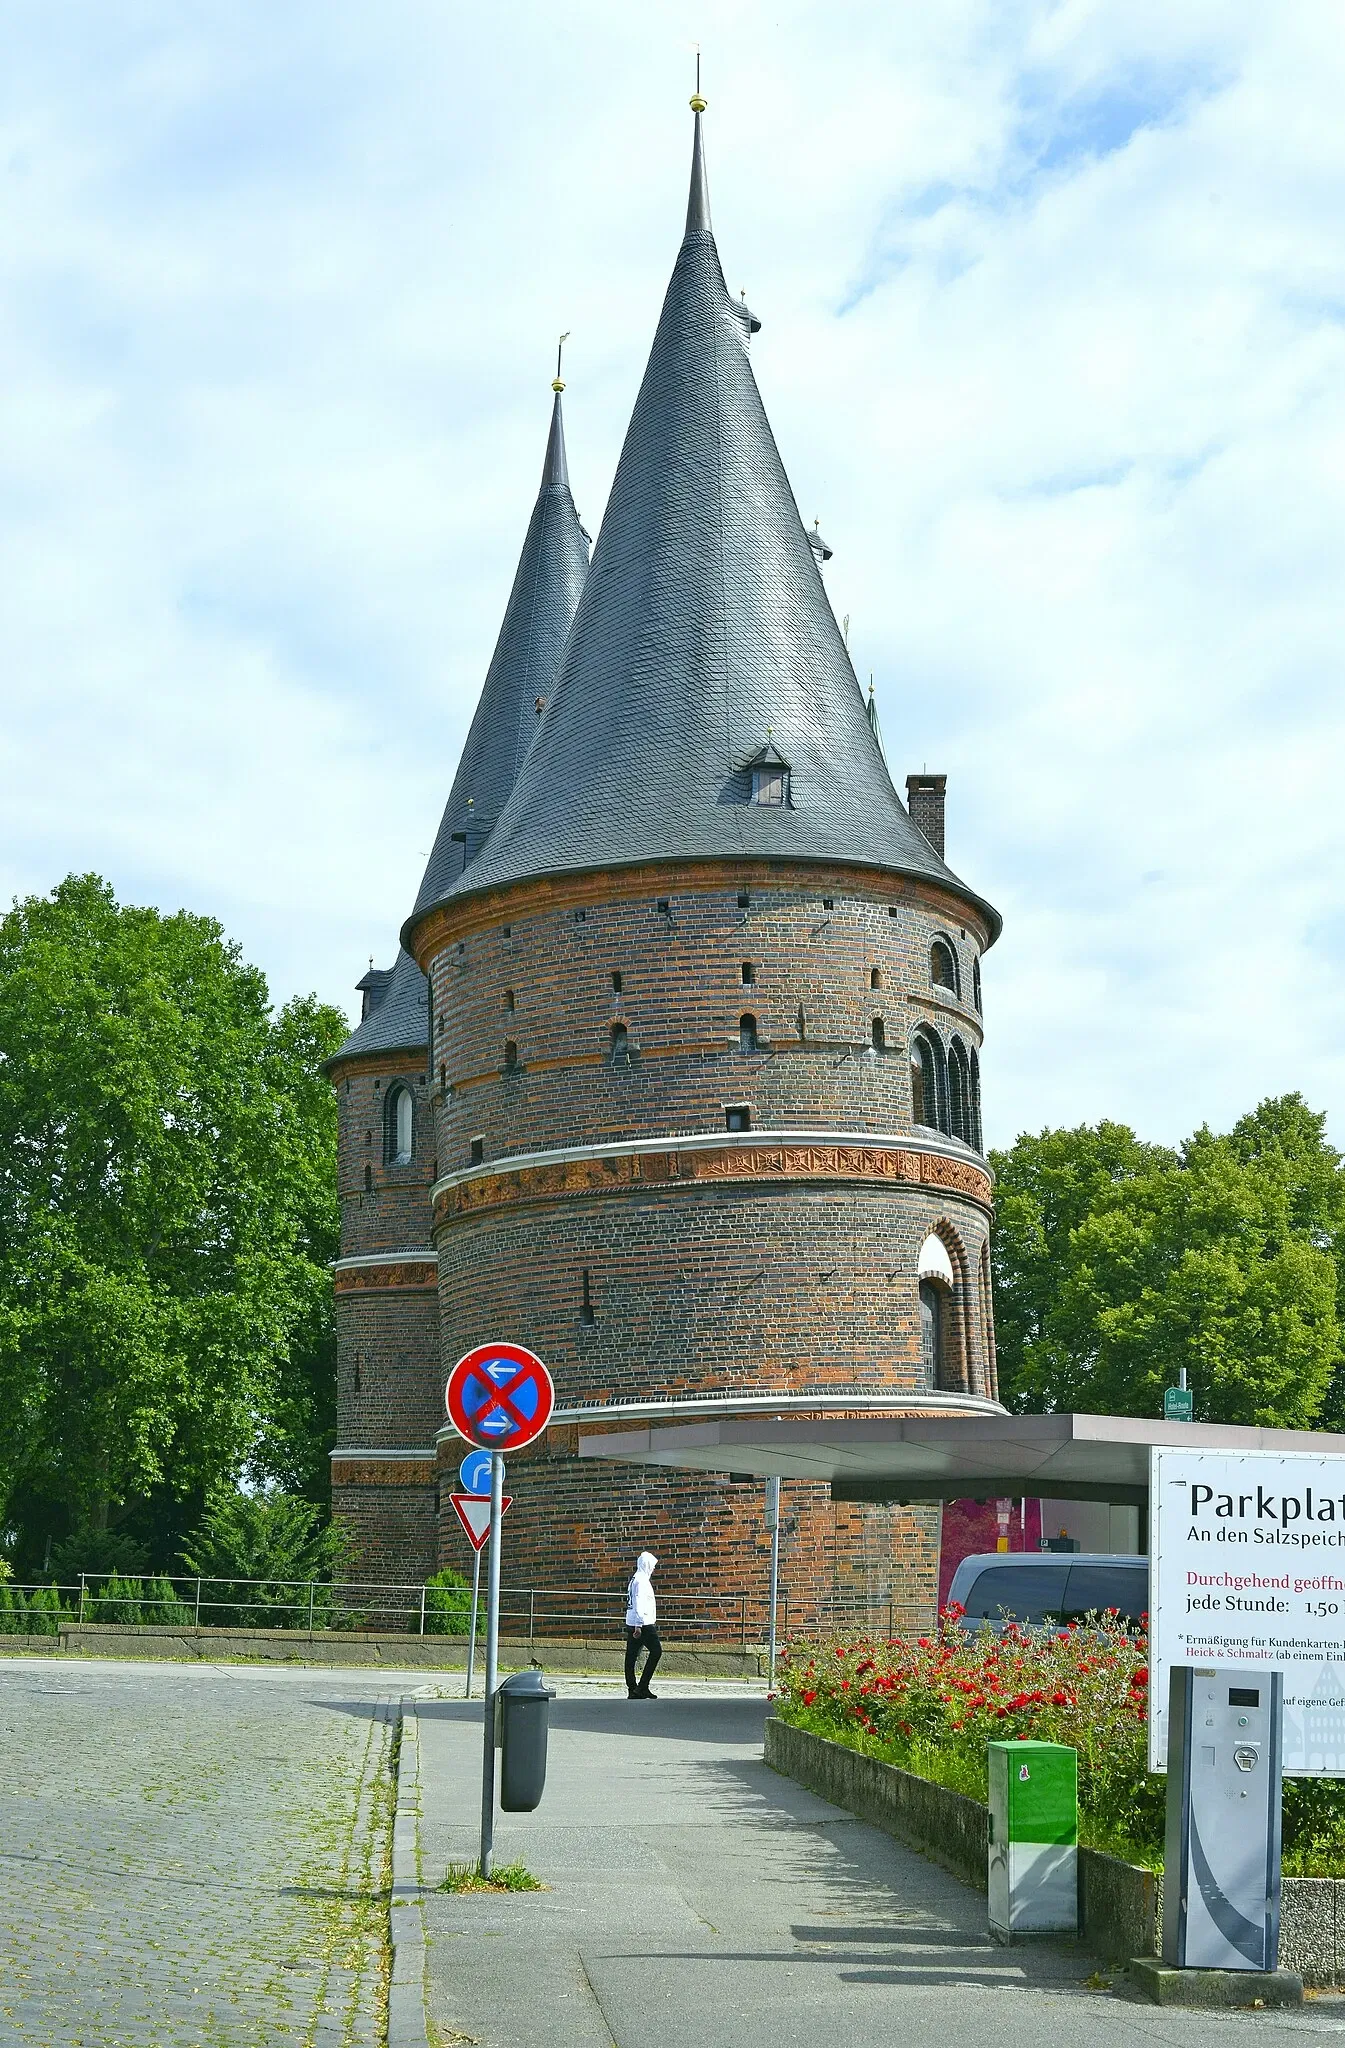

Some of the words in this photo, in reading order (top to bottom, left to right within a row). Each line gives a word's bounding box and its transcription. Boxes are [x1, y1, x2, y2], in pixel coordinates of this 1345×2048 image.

[1187, 1526, 1211, 1541] An
[1216, 1526, 1248, 1543] den
[1253, 1528, 1345, 1549] Salzspeich
[1187, 1571, 1290, 1591] Durchgehend
[1294, 1575, 1345, 1593] geöffn
[1186, 1594, 1221, 1613] jede
[1225, 1596, 1289, 1612] Stunde:
[1304, 1601, 1339, 1618] 1,50
[1186, 1635, 1249, 1648] Ermäßigung
[1251, 1636, 1267, 1647] für
[1186, 1647, 1215, 1657] Heick
[1217, 1649, 1224, 1657] &
[1227, 1649, 1274, 1659] Schmaltz
[1276, 1650, 1291, 1661] (ab
[1293, 1650, 1324, 1661] einem
[1297, 1696, 1327, 1708] eigene
[1329, 1697, 1345, 1706] Gef
